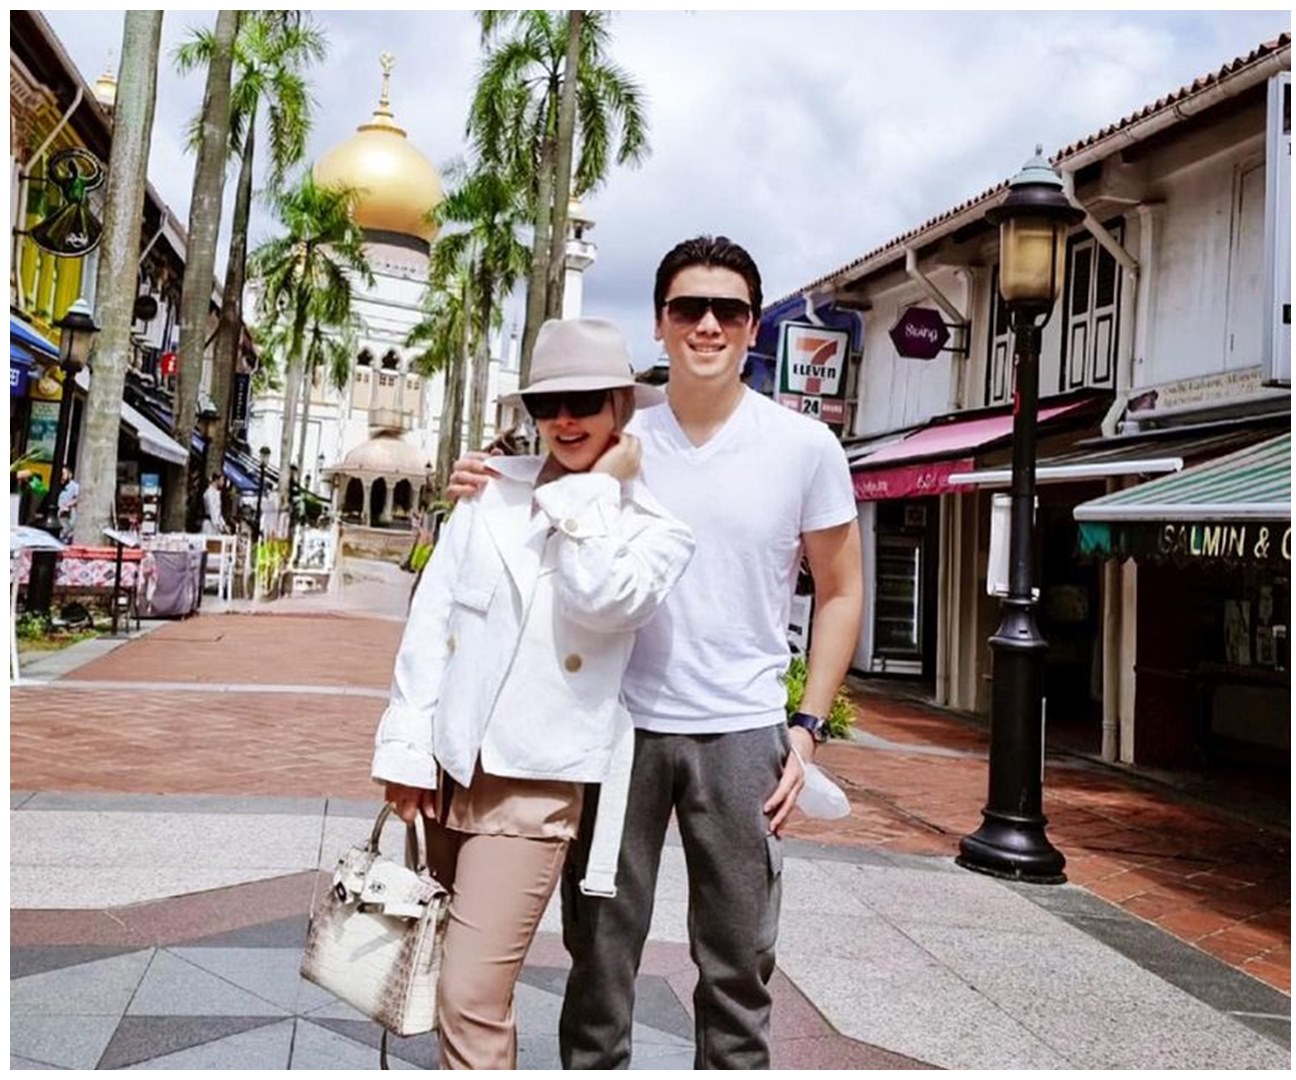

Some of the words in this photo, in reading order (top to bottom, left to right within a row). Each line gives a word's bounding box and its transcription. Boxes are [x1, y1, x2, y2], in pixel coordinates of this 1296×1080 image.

[796, 338, 838, 393] 7
[802, 399, 820, 415] 24
[1160, 524, 1246, 558] SALMIN
[1253, 526, 1271, 559] &
